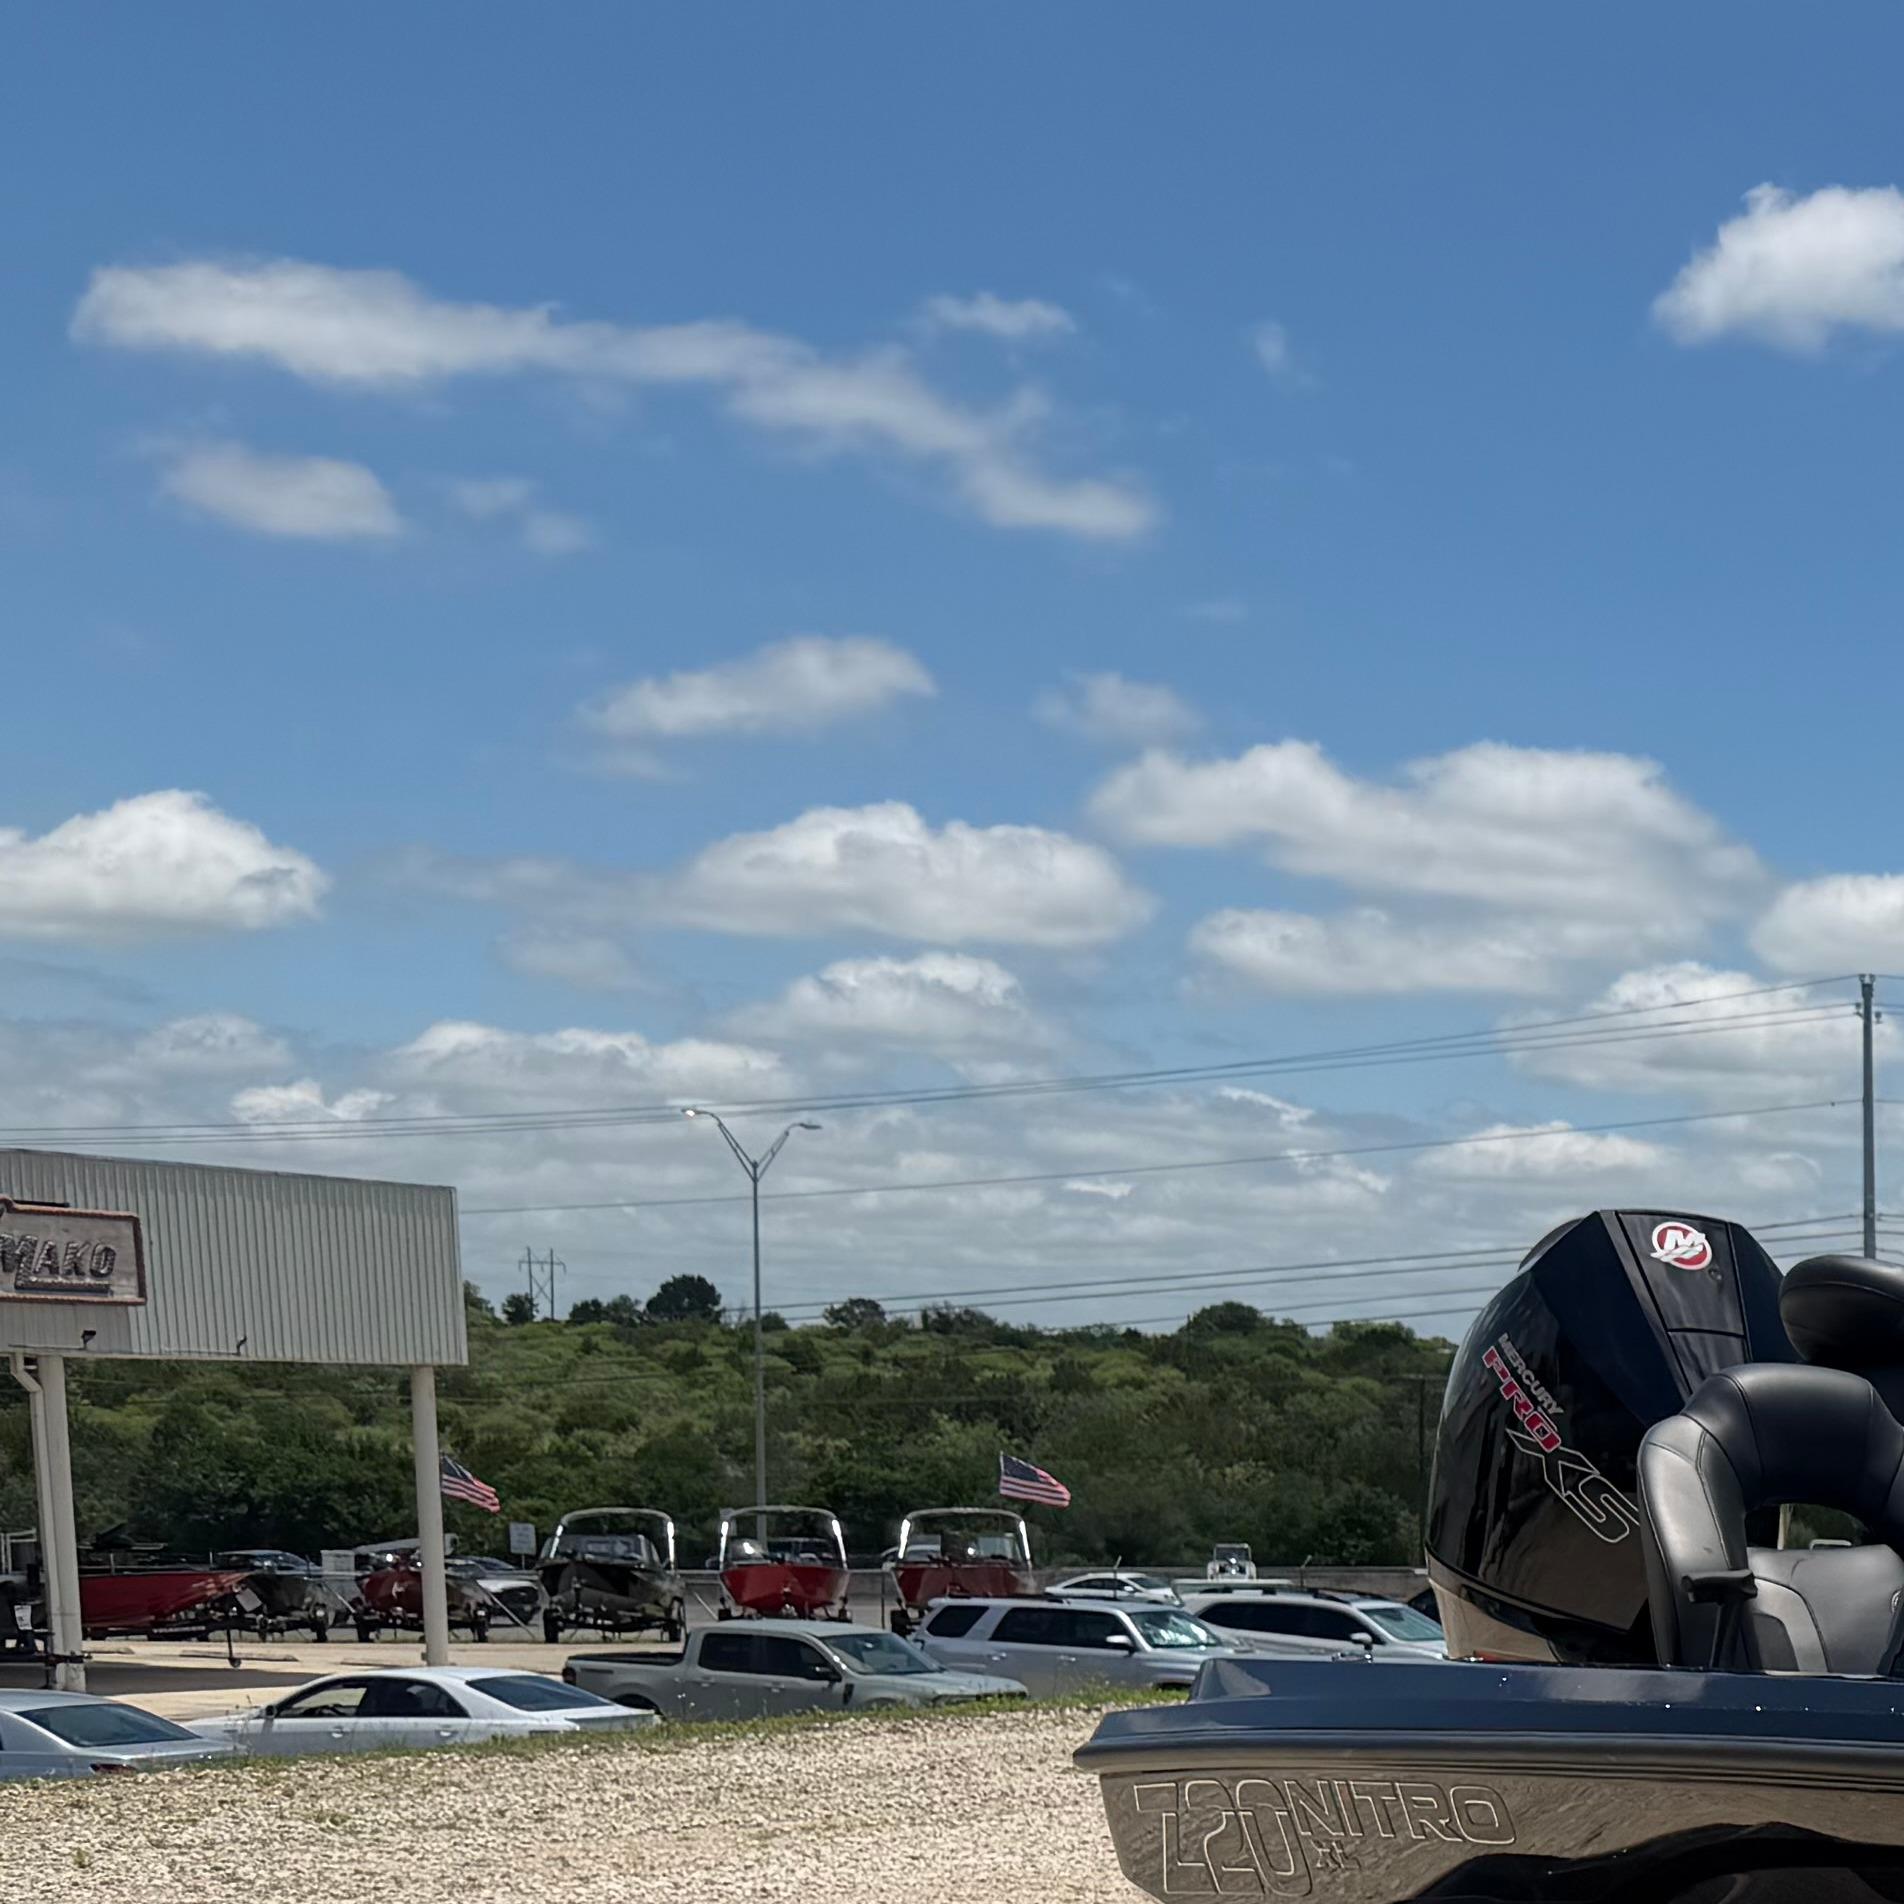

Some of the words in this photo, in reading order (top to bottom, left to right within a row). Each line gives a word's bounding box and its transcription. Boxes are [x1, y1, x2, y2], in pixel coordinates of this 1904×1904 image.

[0, 1233, 116, 1290] MAKO
[1481, 1345, 1562, 1453] PRO
[1498, 1332, 1565, 1415] MERCURY
[1134, 1779, 1313, 1896] Z20
[1283, 1779, 1517, 1845] NITRO
